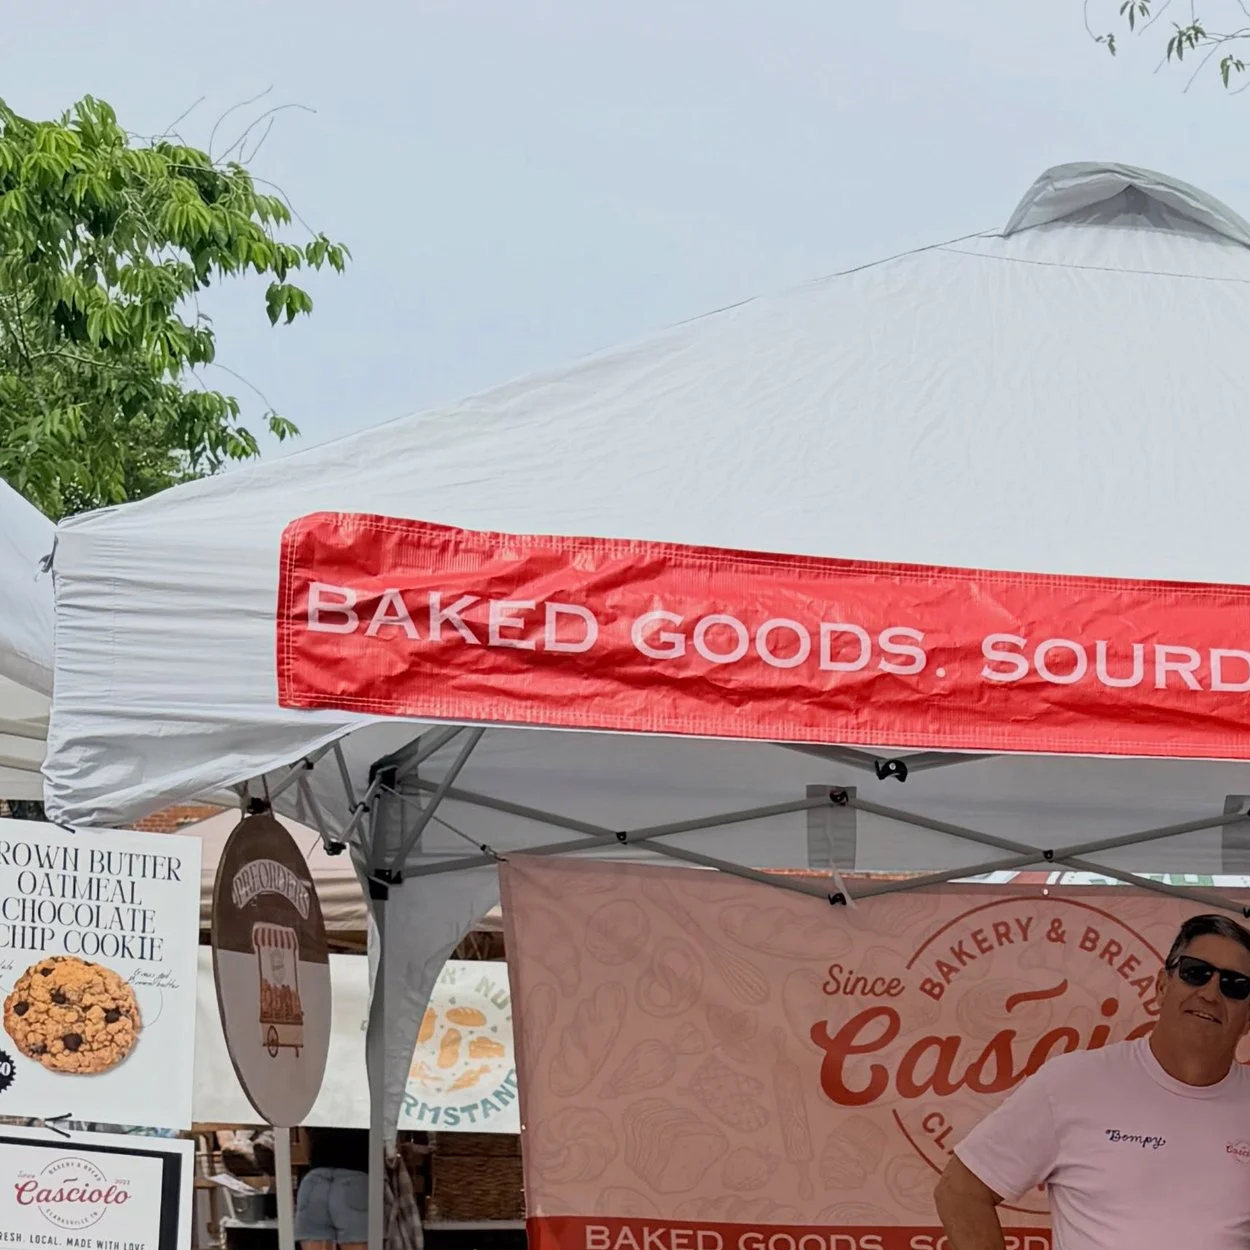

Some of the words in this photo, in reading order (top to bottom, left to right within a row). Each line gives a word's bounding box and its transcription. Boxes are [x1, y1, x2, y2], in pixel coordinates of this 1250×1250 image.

[306, 581, 599, 654] BAKED
[630, 610, 947, 679] GOODS.
[90, 849, 182, 882] BUTTER
[18, 870, 143, 905] OATMEAL
[2, 896, 156, 934] CHOCOLATE
[0, 923, 55, 951] CHIP
[64, 930, 163, 962] COOKIE
[918, 917, 1034, 1001] BAKERY
[1045, 917, 1067, 943] &
[823, 963, 906, 998] Since
[1105, 1129, 1166, 1149] Bompy
[14, 1178, 132, 1206] Casciolo
[30, 1233, 62, 1246] LOCAL.
[66, 1237, 92, 1248] MADE
[96, 1240, 120, 1250] WITH
